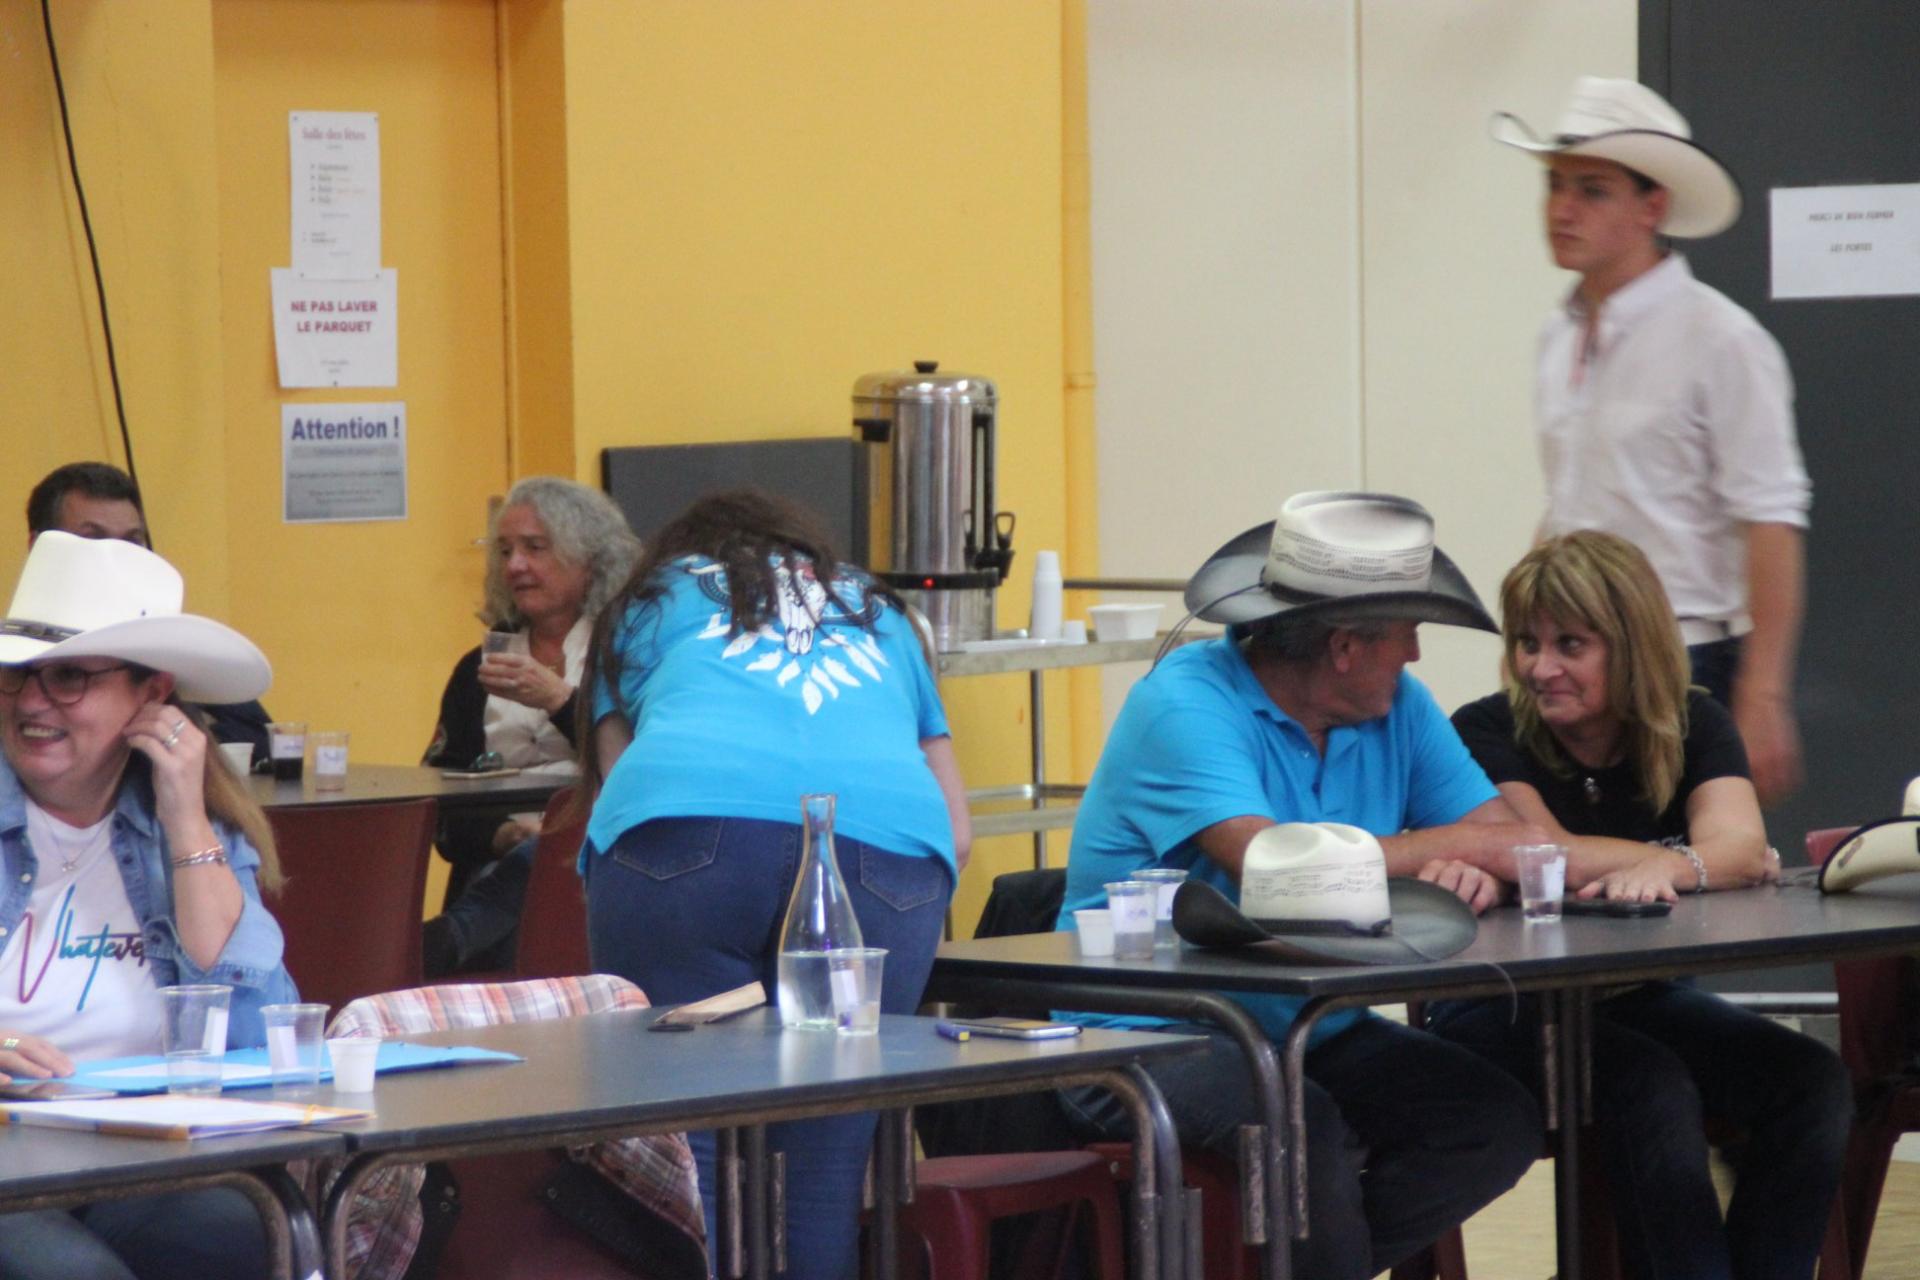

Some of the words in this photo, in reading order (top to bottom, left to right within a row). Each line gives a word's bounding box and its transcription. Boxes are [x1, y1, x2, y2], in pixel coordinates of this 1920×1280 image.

[290, 301, 306, 312] NE
[311, 301, 334, 312] PAS
[338, 301, 377, 312] LAVER
[297, 321, 311, 332] LE
[315, 321, 372, 332] PARQUET
[291, 417, 388, 440] Attention
